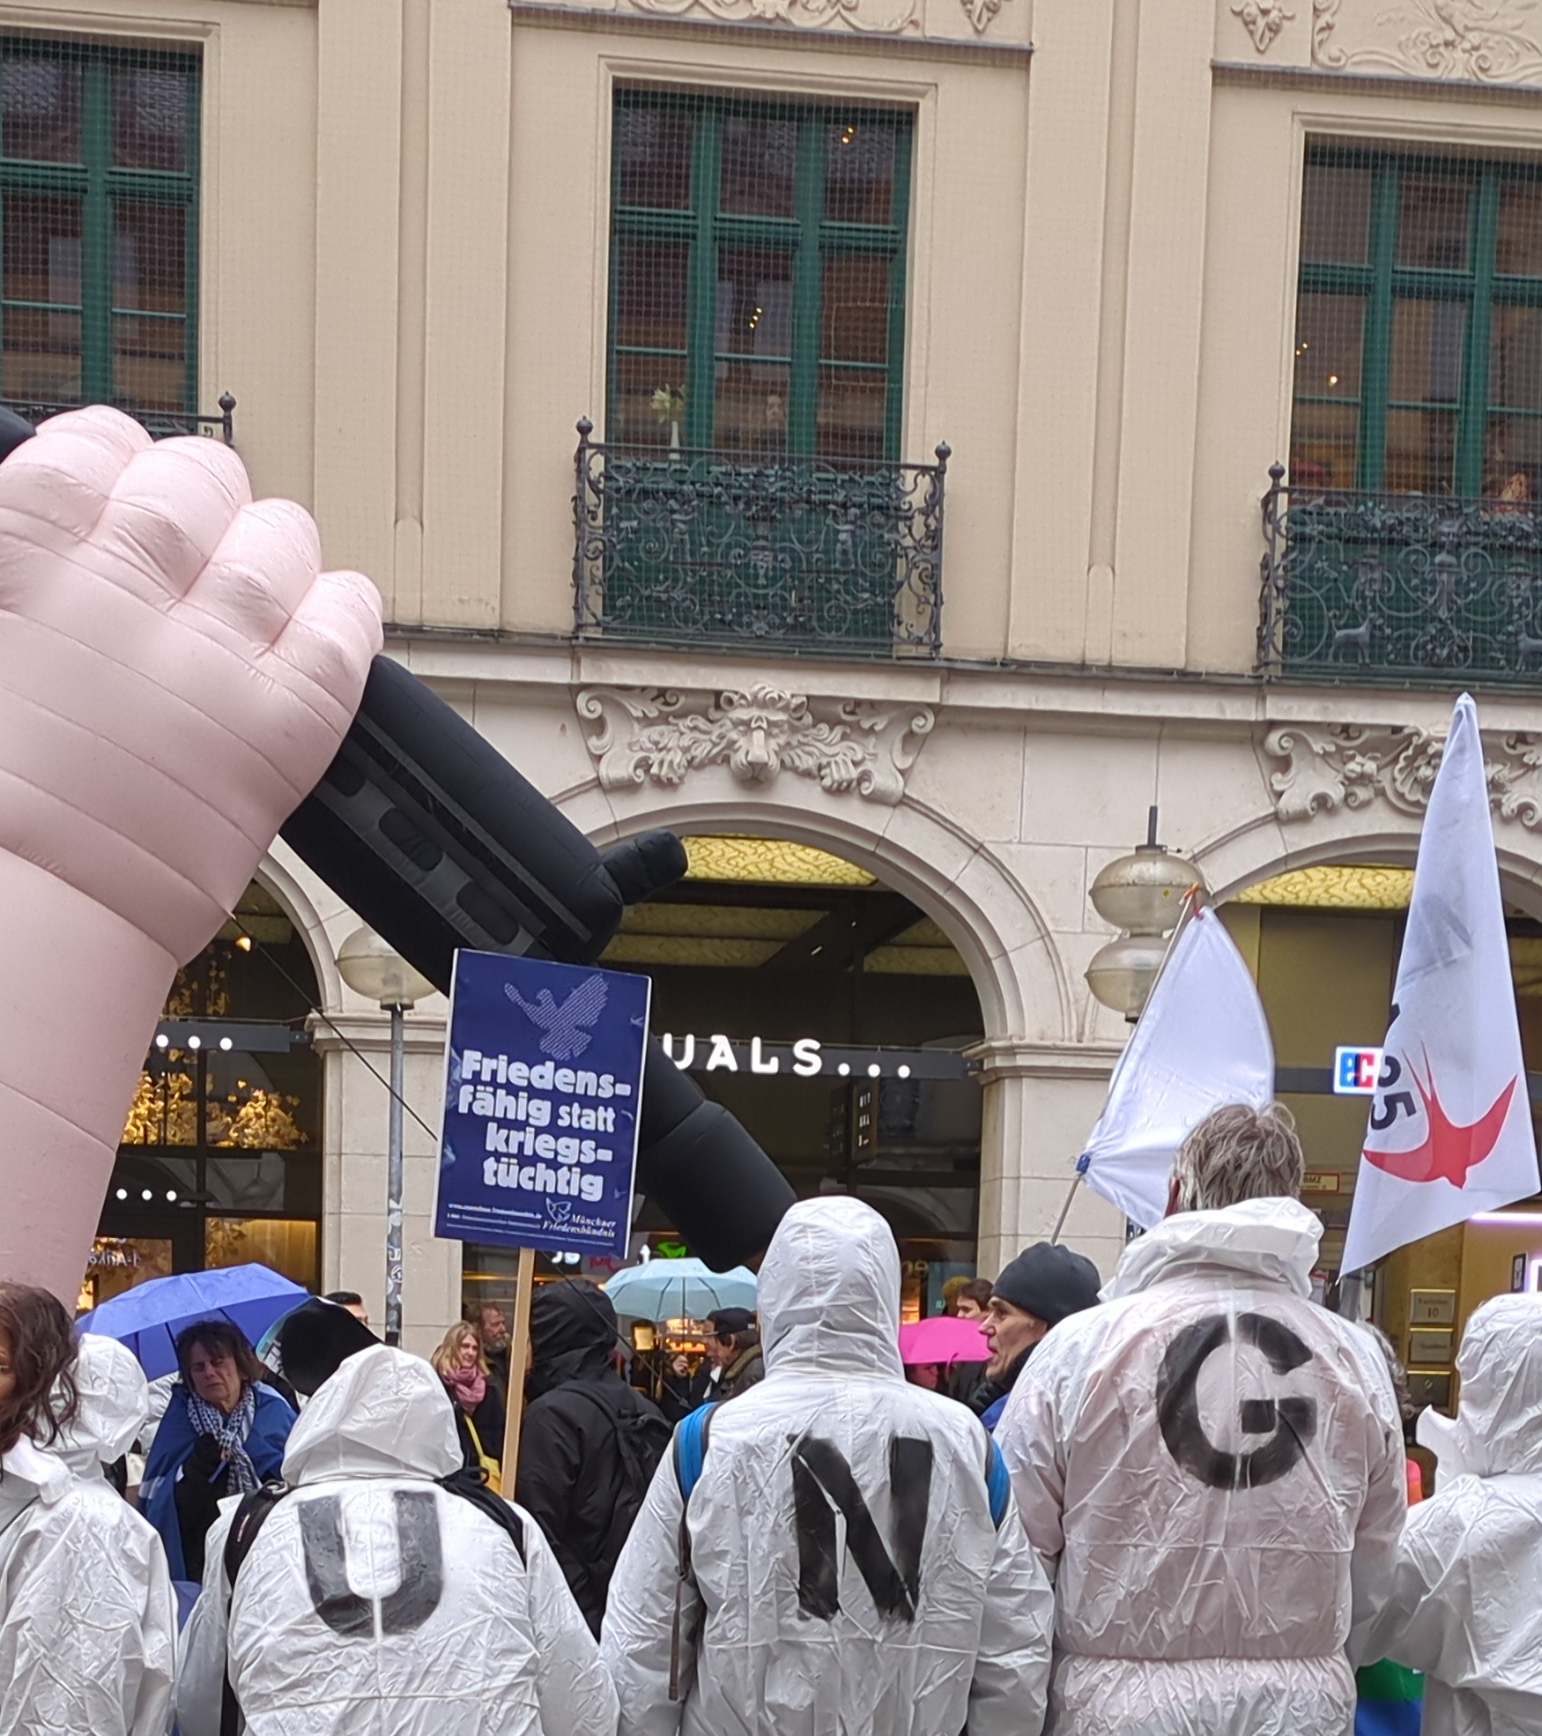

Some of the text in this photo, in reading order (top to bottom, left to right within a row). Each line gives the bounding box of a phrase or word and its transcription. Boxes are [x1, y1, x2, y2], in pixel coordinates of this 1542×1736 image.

[461, 1049, 631, 1098] Friedens-
[458, 1084, 616, 1133] fähig statt
[485, 1121, 613, 1165] kriegs-
[482, 1156, 604, 1202] tüchtig
[1158, 1311, 1317, 1491] G
[787, 1433, 933, 1622] N
[297, 1490, 445, 1638] U
